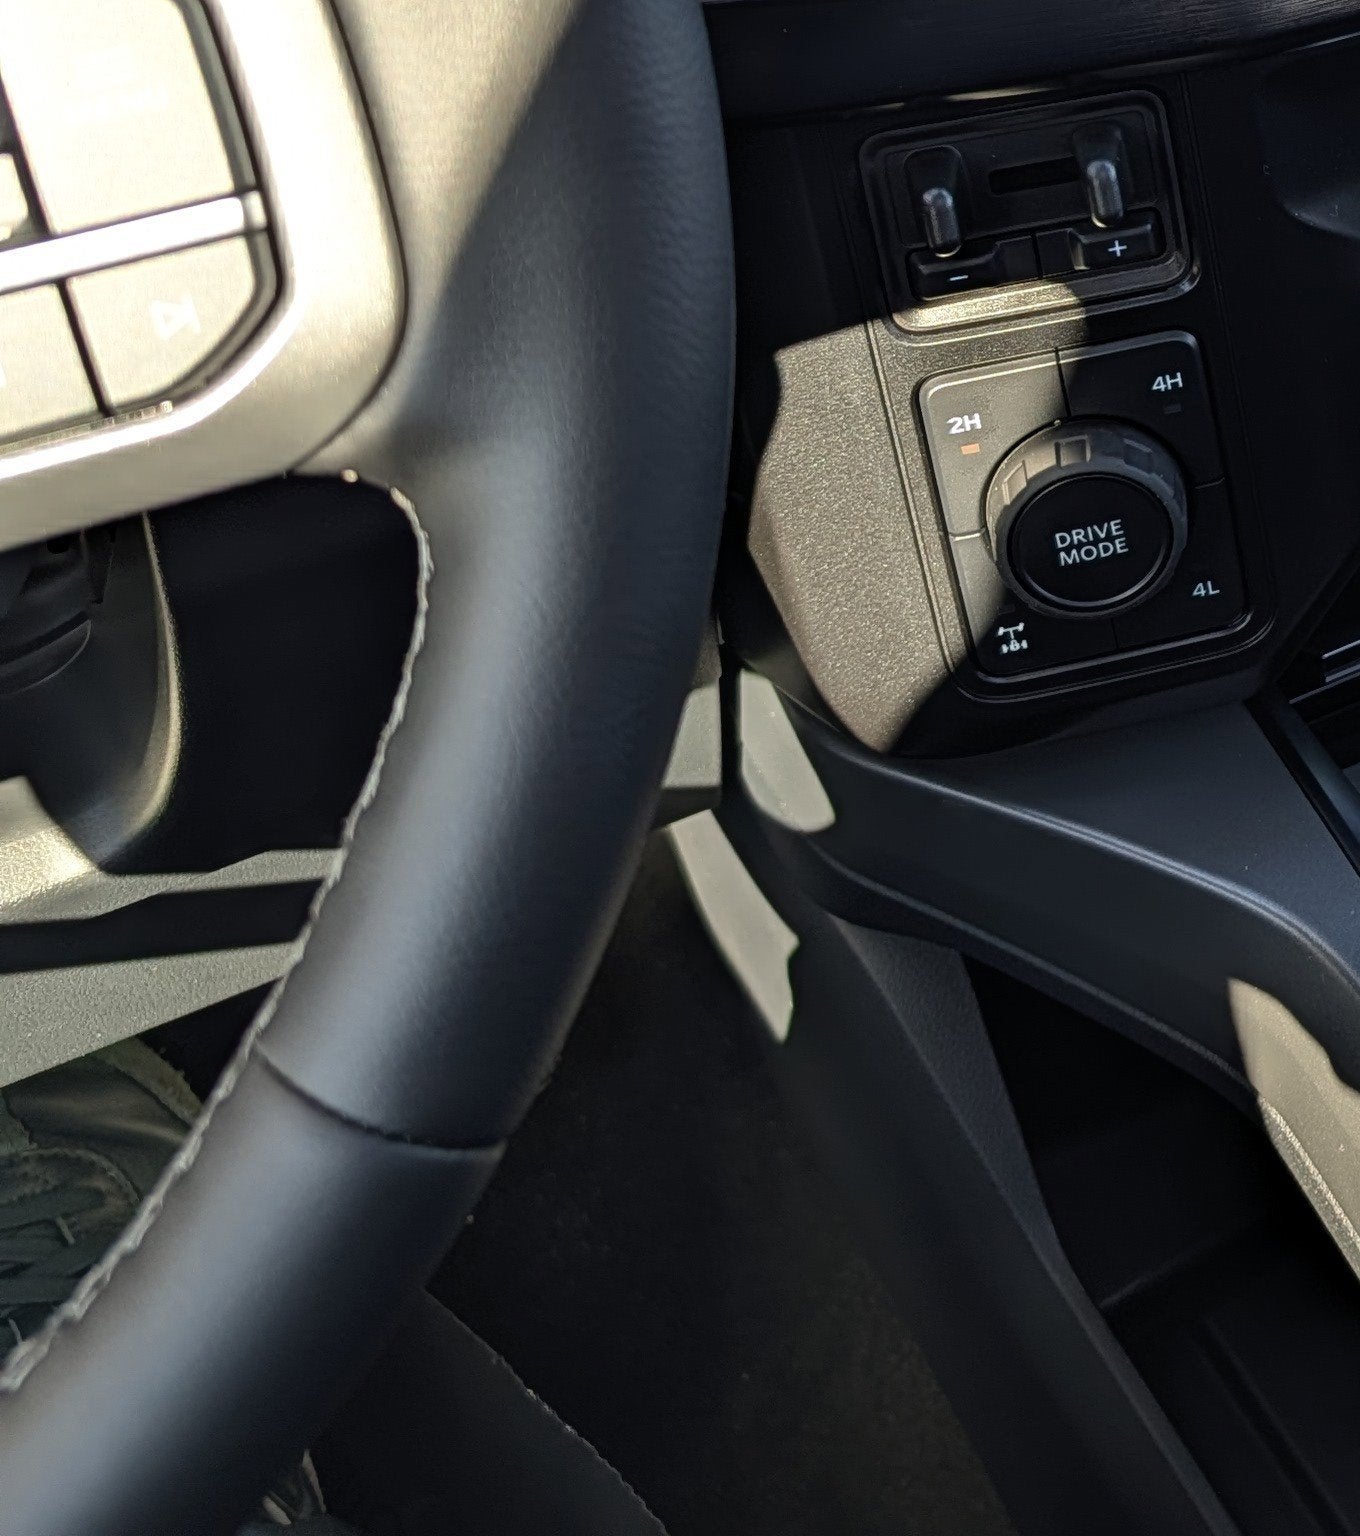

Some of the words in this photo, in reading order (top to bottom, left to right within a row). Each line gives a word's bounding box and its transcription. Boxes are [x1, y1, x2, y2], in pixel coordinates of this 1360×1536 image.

[1151, 372, 1183, 392] 4H
[946, 411, 982, 434] 2H
[1054, 518, 1125, 548] DRIVE
[1059, 537, 1129, 566] MODE
[1192, 581, 1220, 598] 4L
